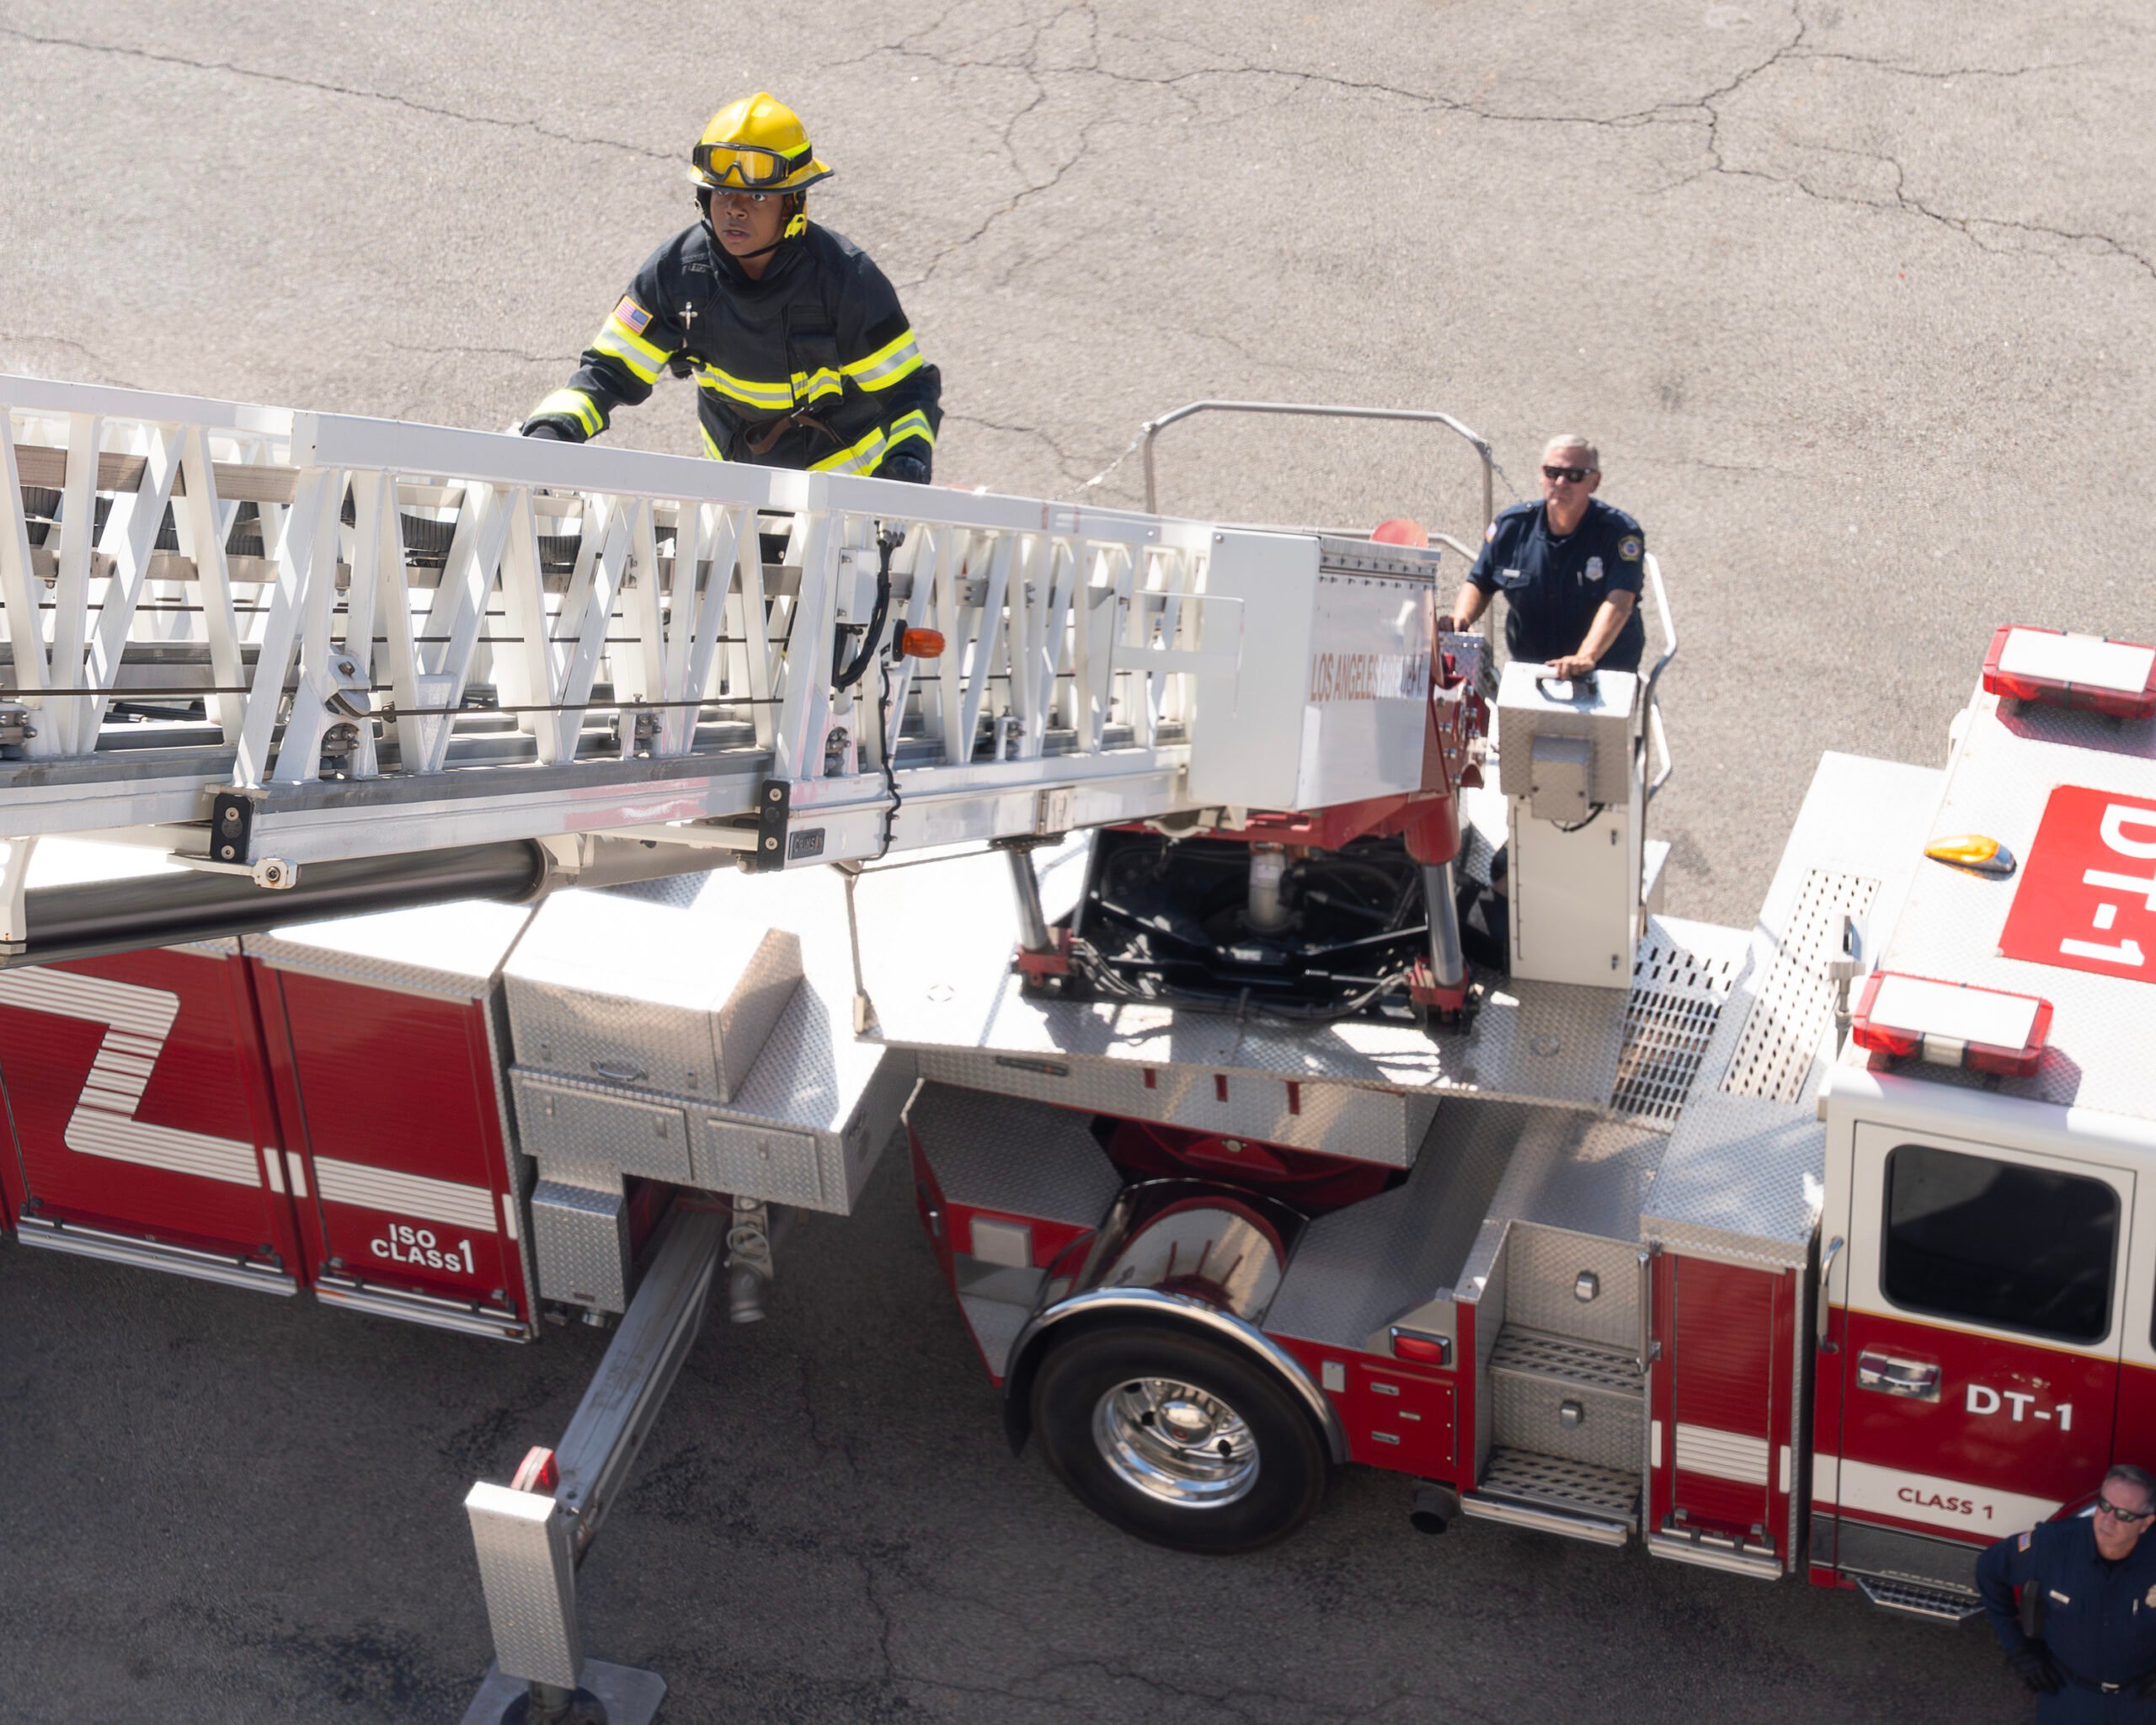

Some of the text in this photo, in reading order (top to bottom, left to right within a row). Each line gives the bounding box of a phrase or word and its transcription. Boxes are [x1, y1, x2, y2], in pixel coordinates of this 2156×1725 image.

[1310, 653, 1334, 702] LOS
[1333, 653, 1379, 701] ANGELES
[2059, 803, 2156, 967] DT-1
[371, 1238, 475, 1274] CLASS 1
[388, 1223, 436, 1248] ISO
[1966, 1383, 2073, 1432] DT-1
[1897, 1487, 1994, 1519] CLASS 1
